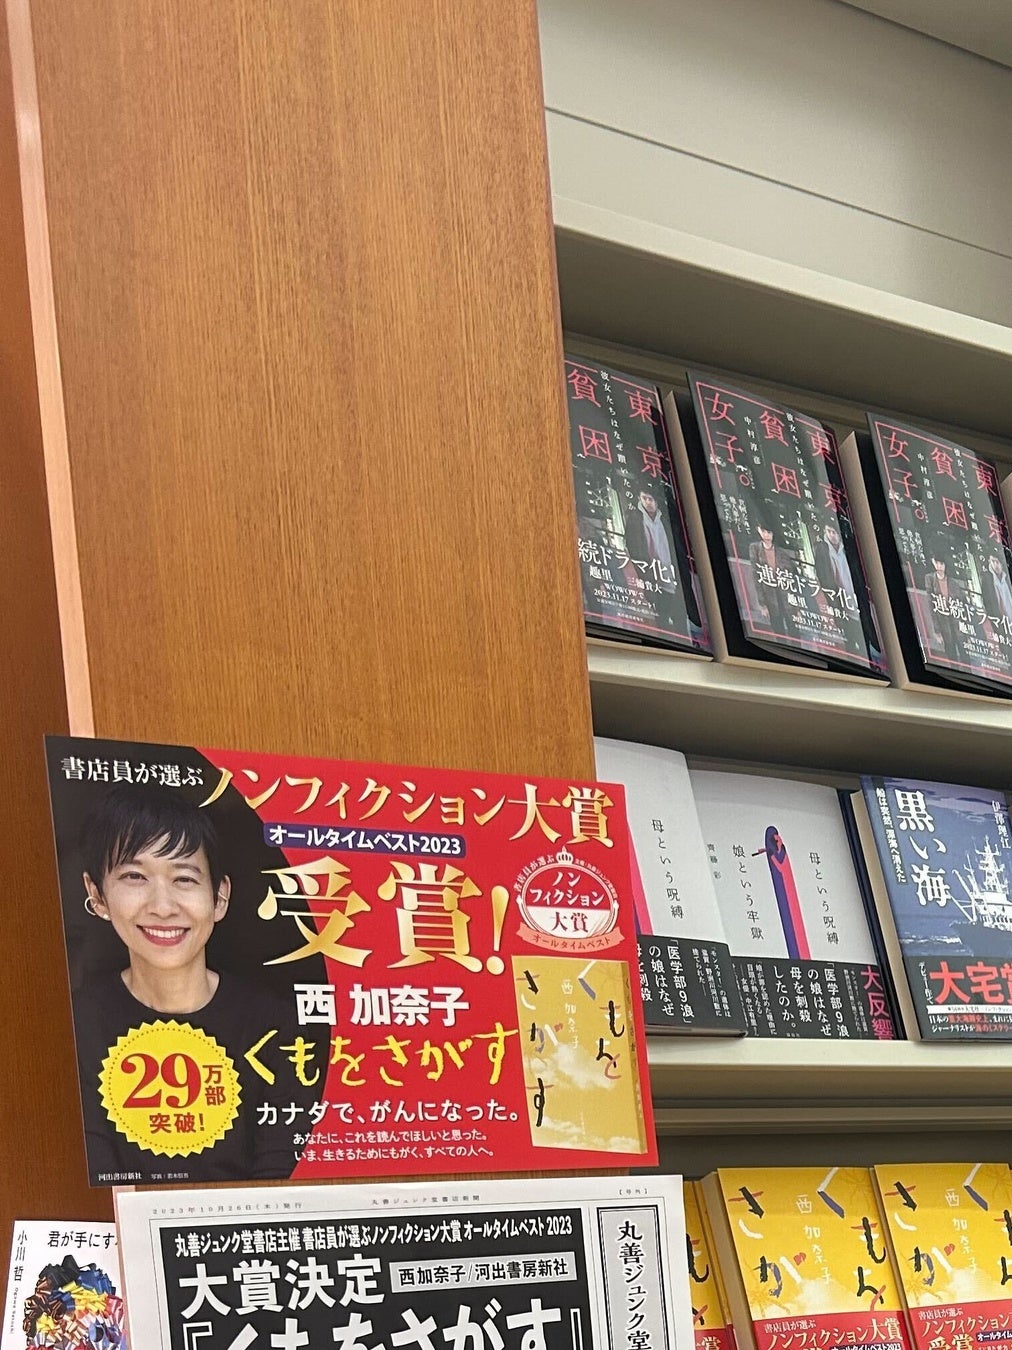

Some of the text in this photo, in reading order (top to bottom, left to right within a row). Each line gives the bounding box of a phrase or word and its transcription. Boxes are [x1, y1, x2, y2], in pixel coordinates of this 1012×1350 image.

[567, 368, 613, 464] 貧困
[623, 389, 671, 481] 東京
[704, 392, 752, 487] 女子。
[760, 409, 802, 499] 貧困
[806, 428, 850, 515] 東京
[883, 431, 926, 521] 女子。
[930, 447, 969, 531] 貧困
[577, 537, 679, 586] 続ドラマ化!
[757, 563, 861, 614] 連続ドラマ化!
[61, 756, 614, 849] 書店員が選ぶ ノンフィクション大賞
[269, 825, 463, 857] オールタイムベスト2023
[651, 818, 685, 919] 母という呪縛
[894, 788, 953, 907] 黒い海
[529, 888, 604, 906] フィクション
[552, 871, 581, 887] ノン
[732, 844, 765, 940] 娘という牢獄
[809, 852, 840, 945] 母という呪縛
[256, 855, 510, 975] 受賞!
[533, 934, 611, 949] オールタイムベスト
[551, 912, 589, 933] 大賞
[294, 984, 469, 1029] 西 加奈子
[649, 945, 675, 1017] の娘はなぜ
[666, 939, 696, 1025] 「医学部9浪」
[773, 966, 797, 1029] したのか。
[790, 968, 812, 1024] 母を刺殺
[860, 967, 894, 1040] 大反響
[119, 1052, 202, 1110] 29
[242, 1021, 519, 1087] くもをさがす
[149, 1112, 206, 1135] 突破!
[256, 1100, 519, 1126] カナダで、がんになった。
[293, 1131, 488, 1146] あなたに、これを読んでほしいと思った。
[98, 1170, 143, 1182] 河出書房新社
[294, 1146, 495, 1163] いま、生きるためにもがく、すべての人へ。
[14, 1230, 28, 1282] 小川哲
[47, 1230, 121, 1249] 君が手にす
[174, 1215, 573, 1257] 丸善ジュンク堂書店主催 書店員が選ぶノンフィクション大賞 オールタイムベスト 2023
[179, 1256, 386, 1320] 大賞決定
[918, 1307, 964, 1320] 書店員が選ぶ
[764, 1319, 817, 1333] 書店員が選ぶ
[767, 1318, 903, 1350] ノンフィクション大賞
